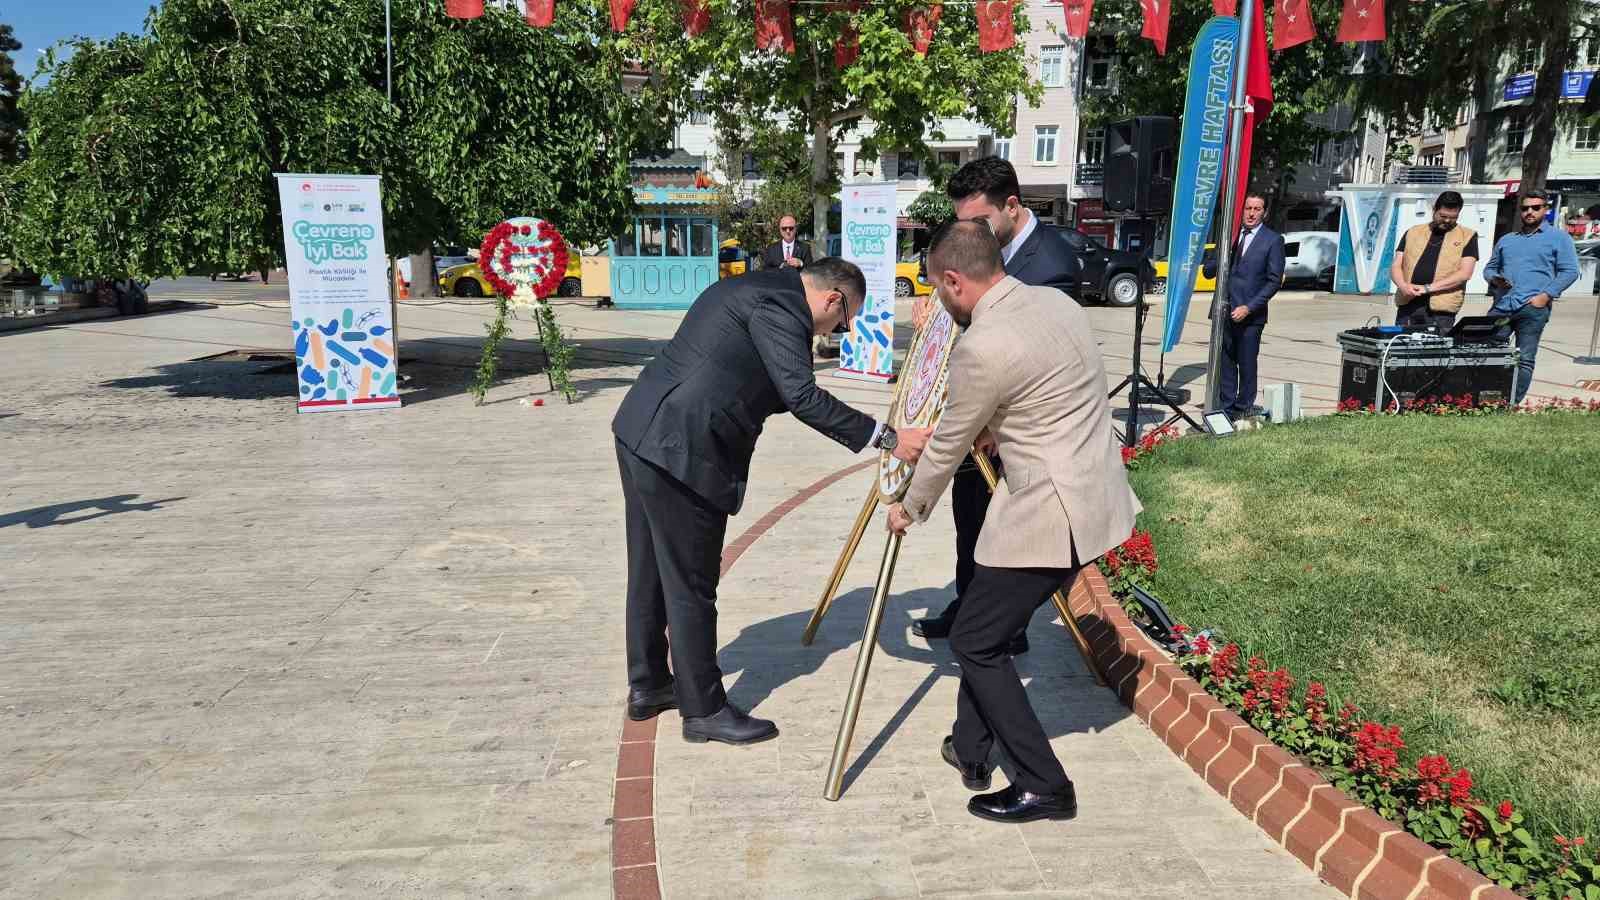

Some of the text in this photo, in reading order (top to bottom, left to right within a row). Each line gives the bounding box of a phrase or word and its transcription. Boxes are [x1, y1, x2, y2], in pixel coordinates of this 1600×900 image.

[1201, 38, 1234, 143] HAFTASI
[293, 220, 373, 244] Çevrene
[331, 240, 366, 259] Bak
